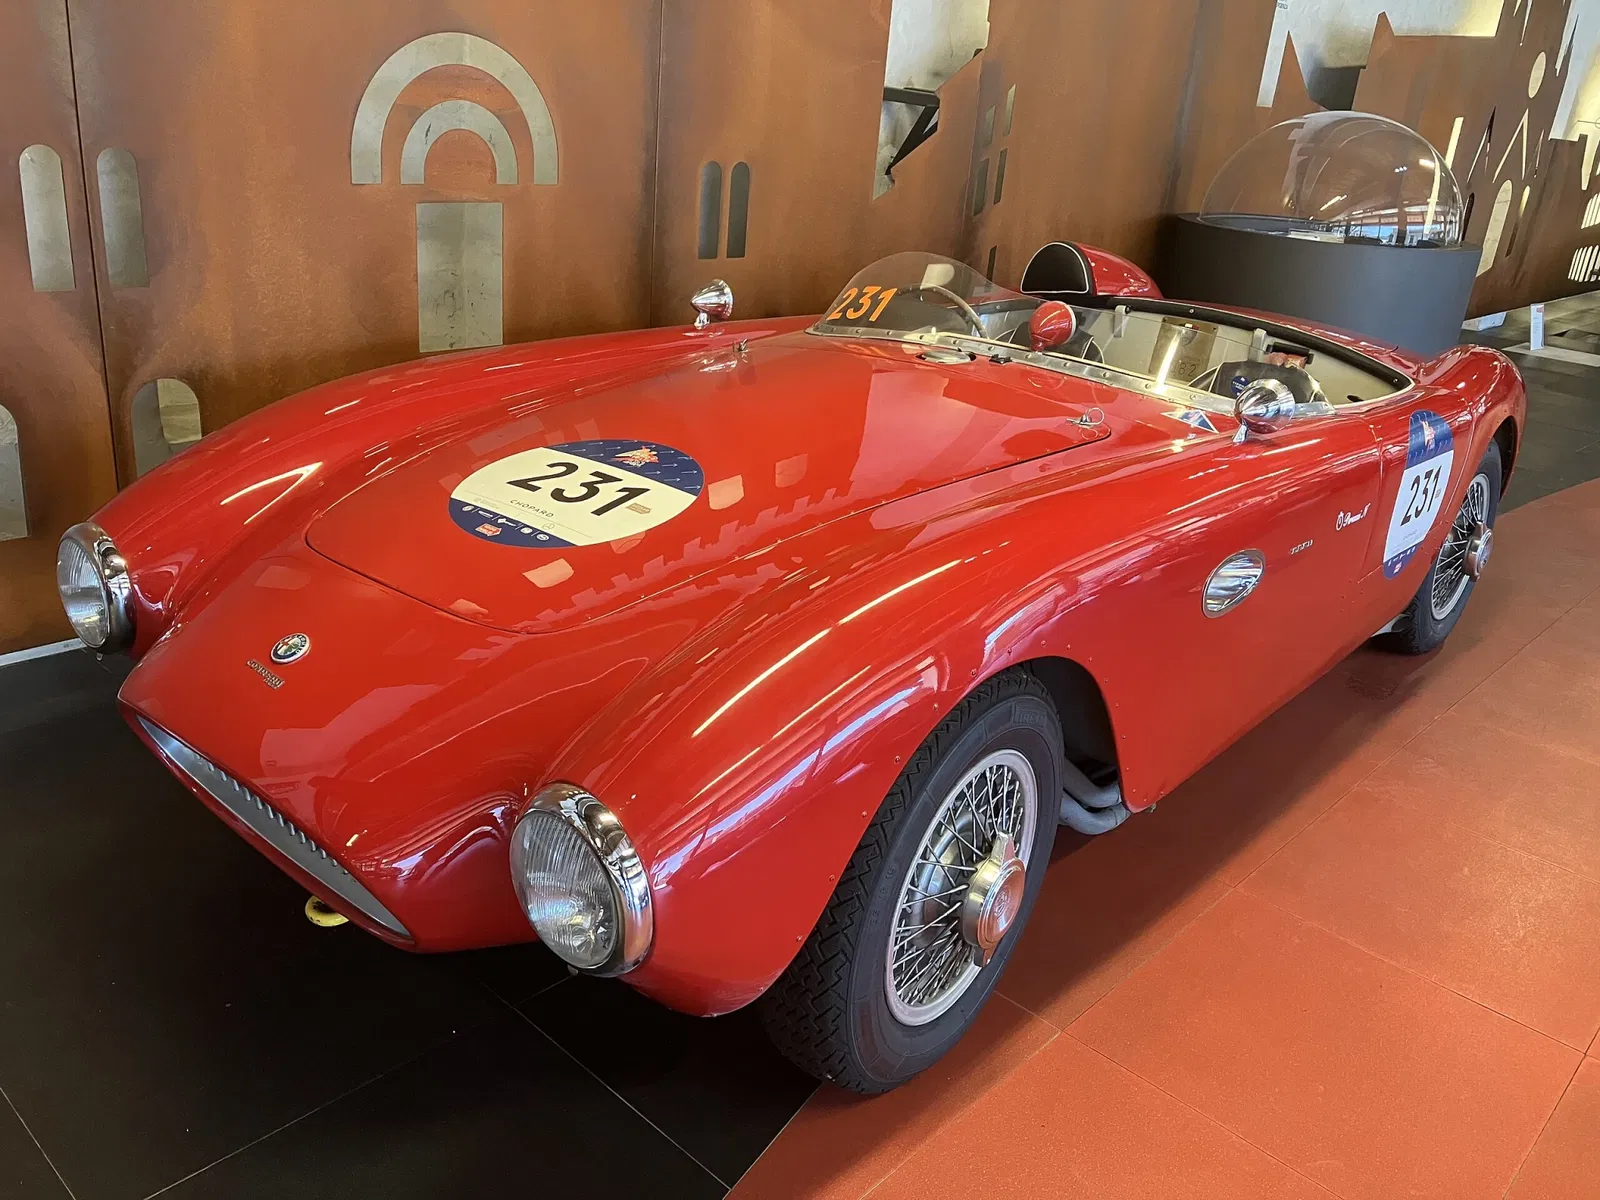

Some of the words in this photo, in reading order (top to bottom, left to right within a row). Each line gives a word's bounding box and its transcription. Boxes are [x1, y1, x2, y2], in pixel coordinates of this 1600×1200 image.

[825, 286, 898, 322] 231
[506, 462, 651, 516] 231
[510, 500, 554, 518] CHOPARD
[1400, 465, 1442, 527] 231
